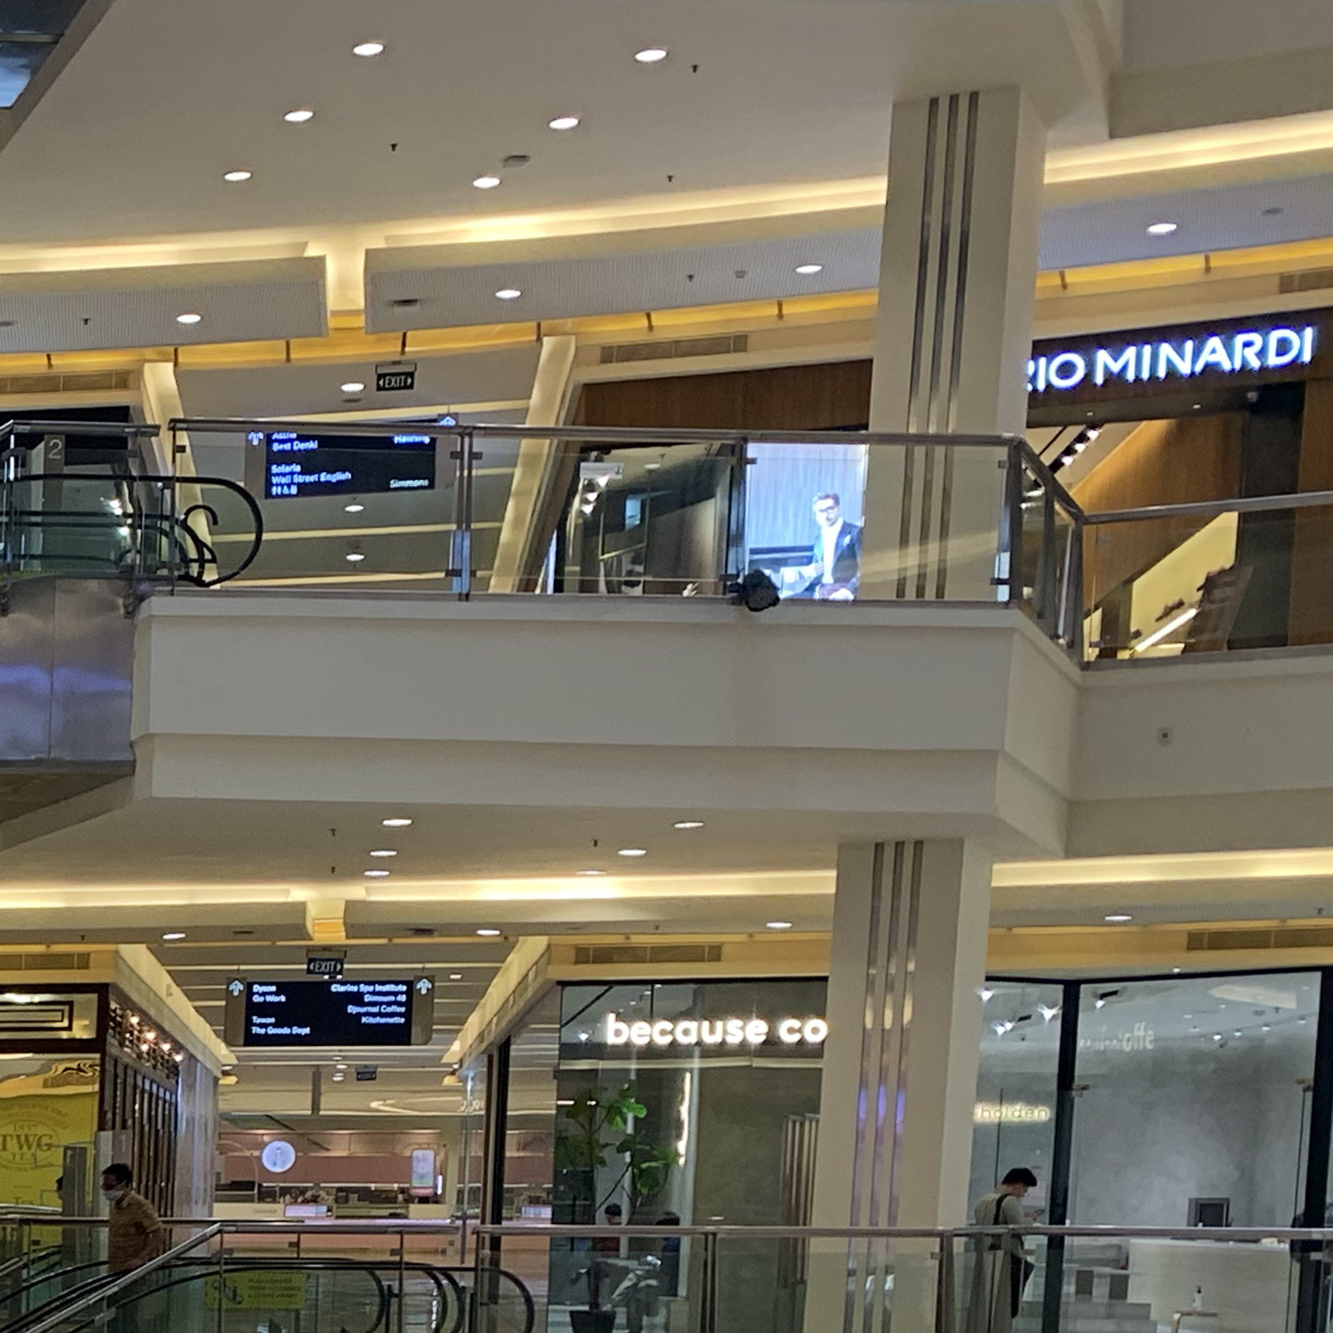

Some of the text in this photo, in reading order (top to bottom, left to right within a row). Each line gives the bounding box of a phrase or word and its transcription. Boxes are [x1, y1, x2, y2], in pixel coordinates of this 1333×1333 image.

[1094, 326, 1313, 387] MINARDI
[385, 376, 406, 388] EXIT
[49, 439, 63, 459] 2
[271, 471, 352, 484] Wall Street English
[389, 478, 429, 489] Simmons
[315, 961, 335, 972] EXIT
[265, 994, 286, 1002] Work
[251, 1026, 266, 1034] The
[606, 1012, 829, 1046] because co
[980, 1104, 1049, 1120] holden
